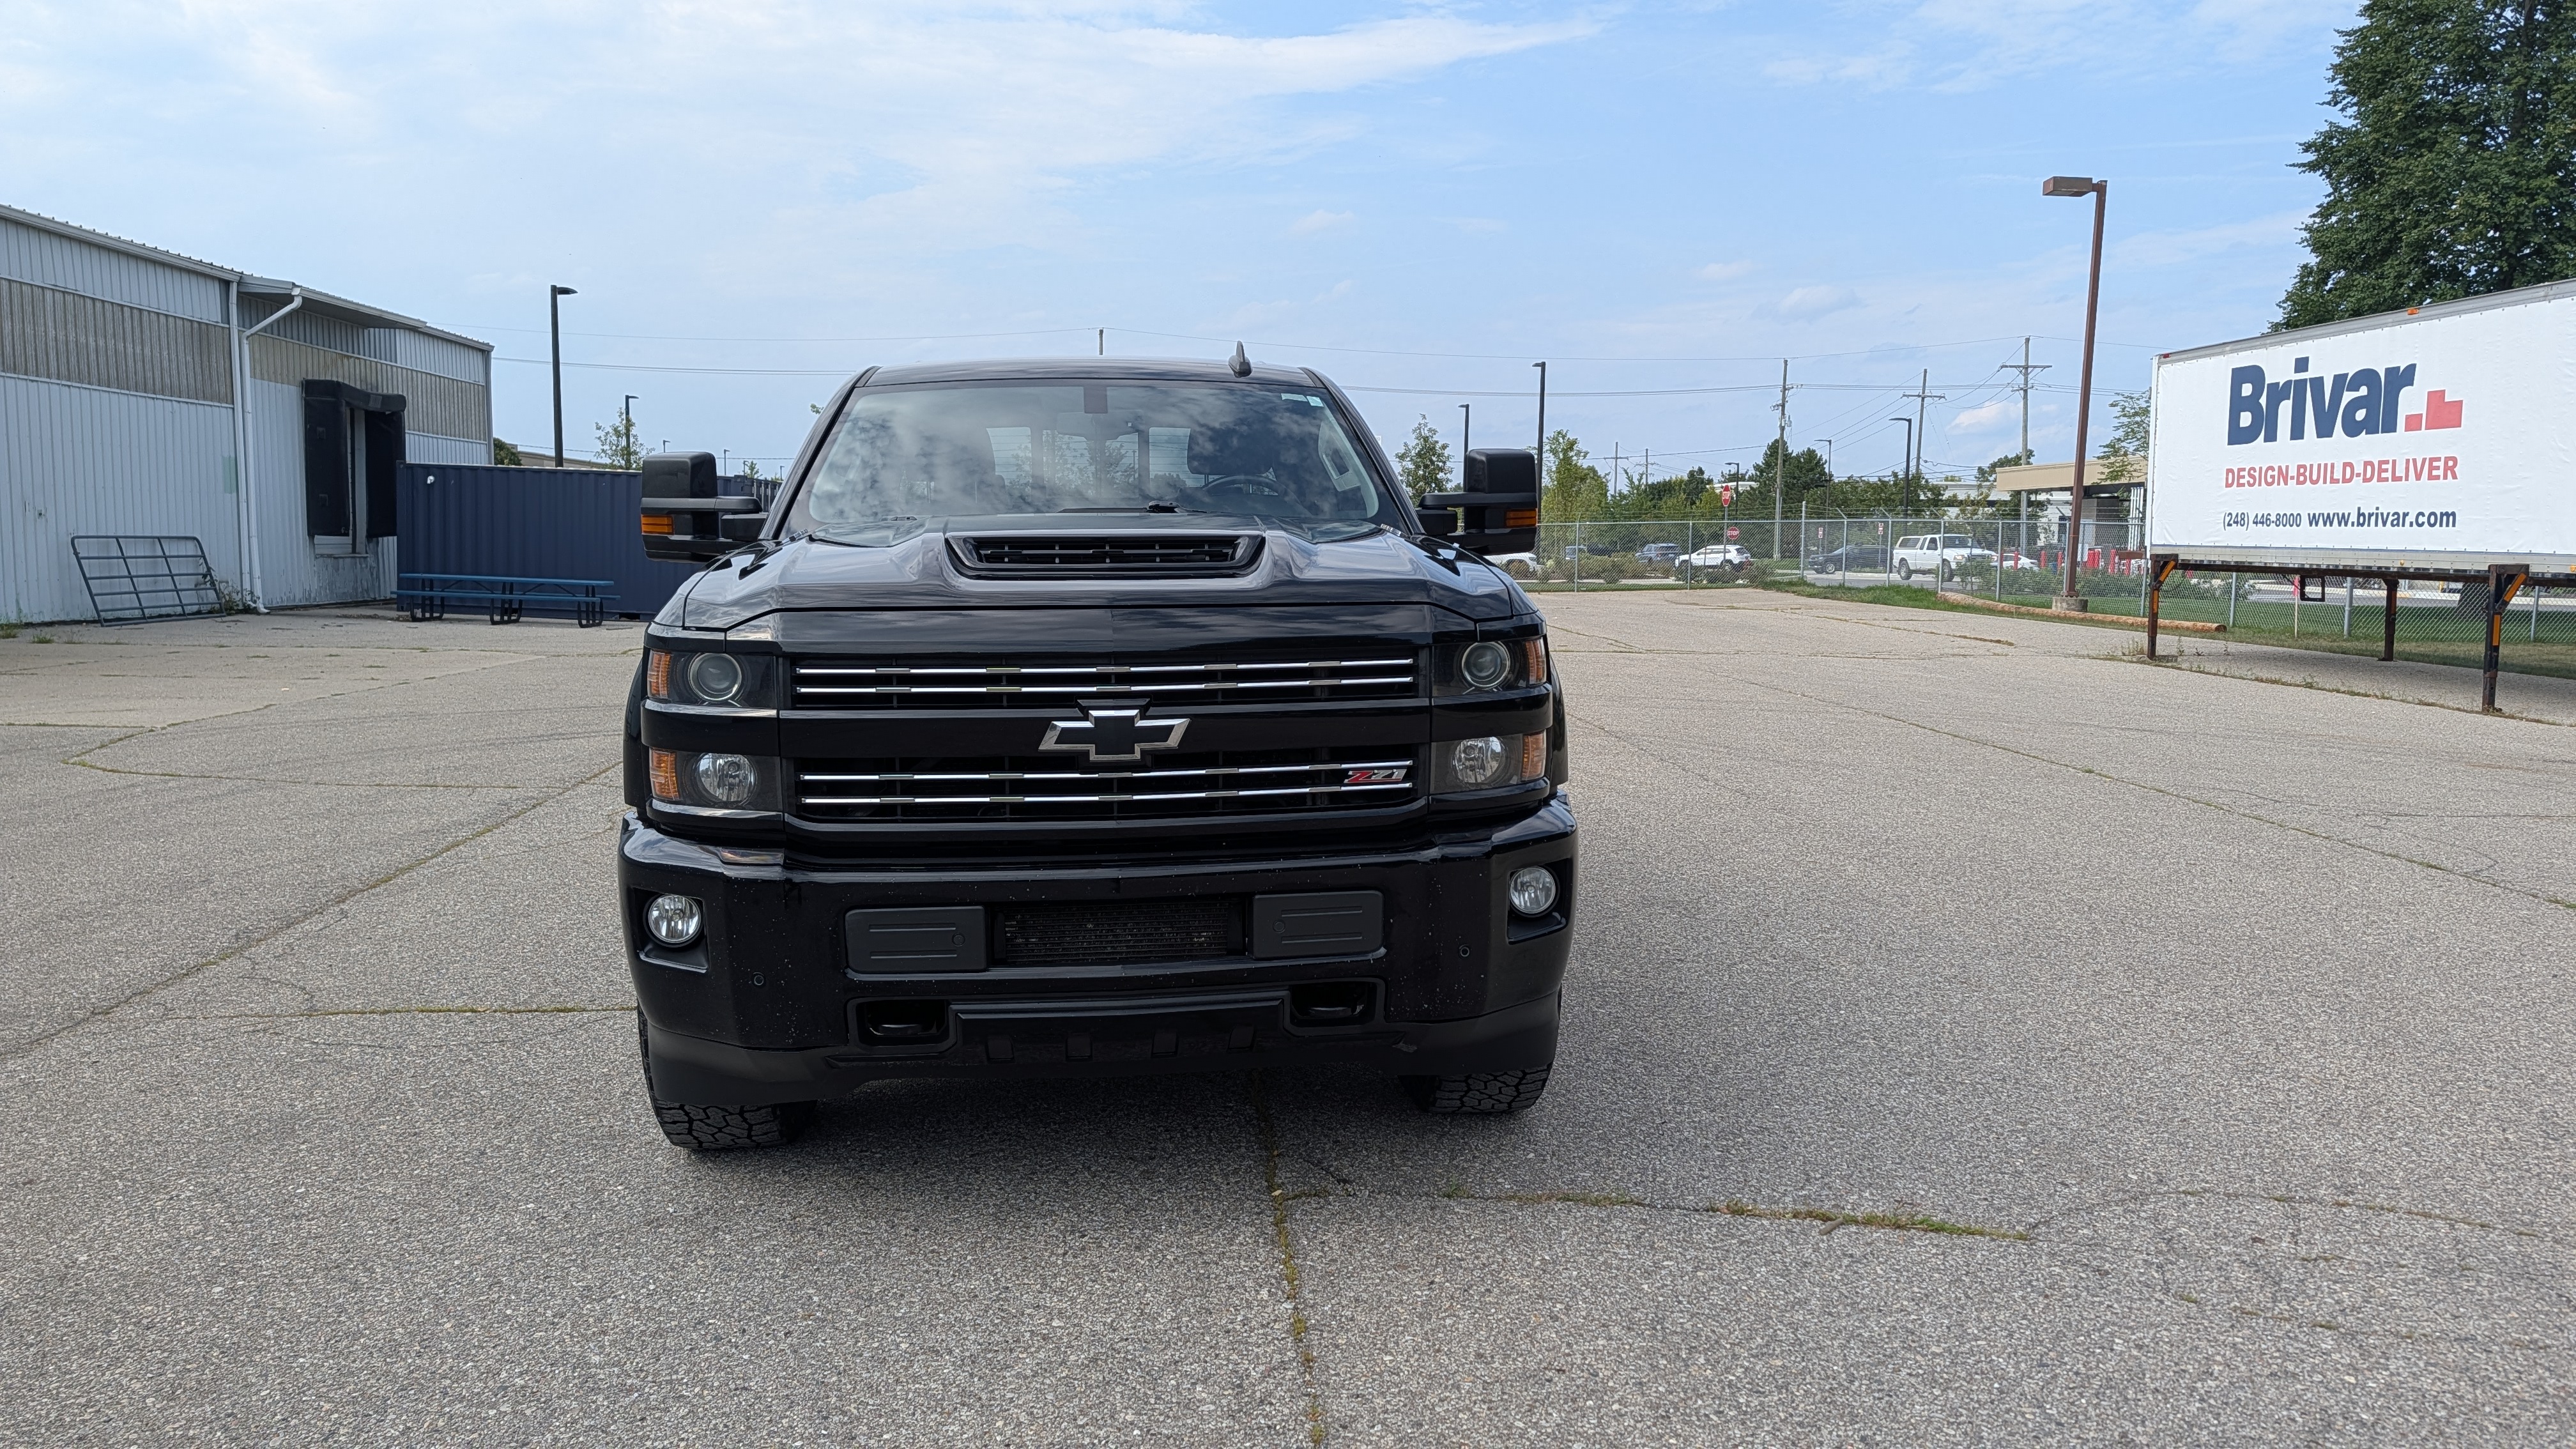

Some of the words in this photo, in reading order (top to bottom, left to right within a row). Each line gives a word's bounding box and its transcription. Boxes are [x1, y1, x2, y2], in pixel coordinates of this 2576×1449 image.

[2225, 456, 2458, 488] DESIGN-BUILD-DELIVER
[2223, 512, 2250, 531] (248)
[2252, 512, 2301, 528] 446-8000
[2308, 507, 2457, 528] www.brivar.com
[1344, 769, 1407, 783] Z71
